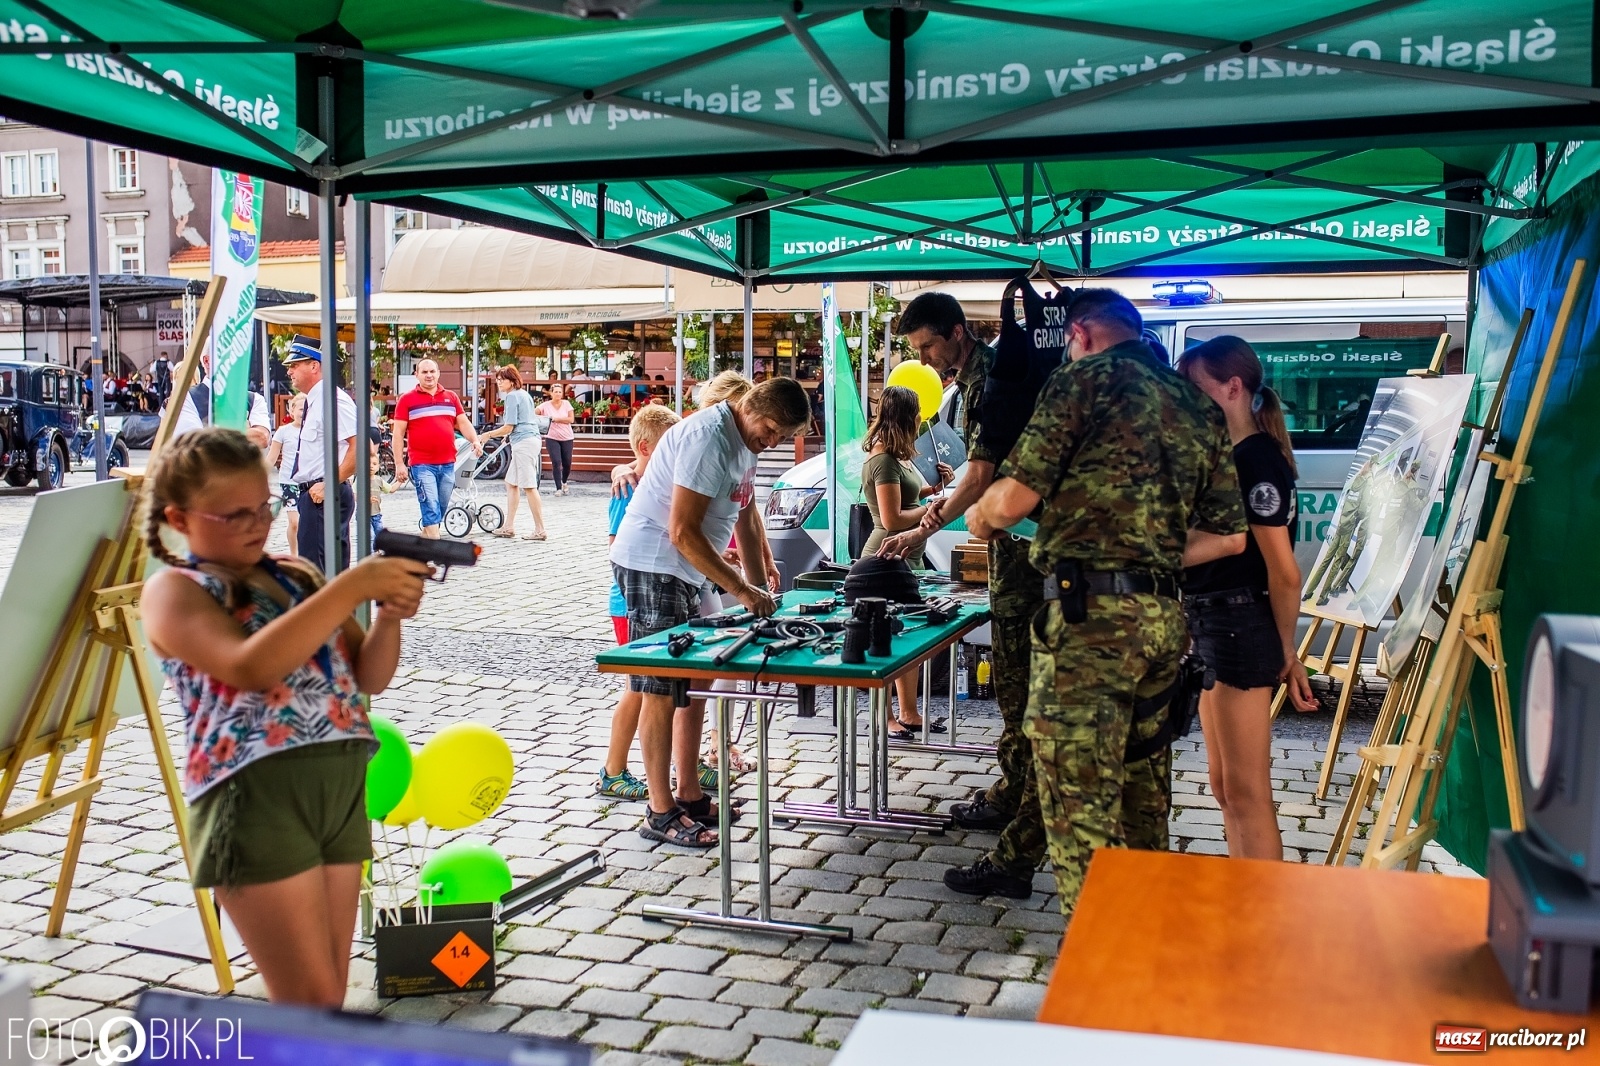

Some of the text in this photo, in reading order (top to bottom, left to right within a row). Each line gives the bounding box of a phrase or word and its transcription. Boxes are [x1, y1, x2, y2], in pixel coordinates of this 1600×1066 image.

[539, 312, 570, 320] BROWAR
[1042, 306, 1068, 327] STRA
[158, 329, 184, 343] ŚLĄS
[1033, 328, 1066, 349] GRANI
[450, 945, 471, 959] 1.4
